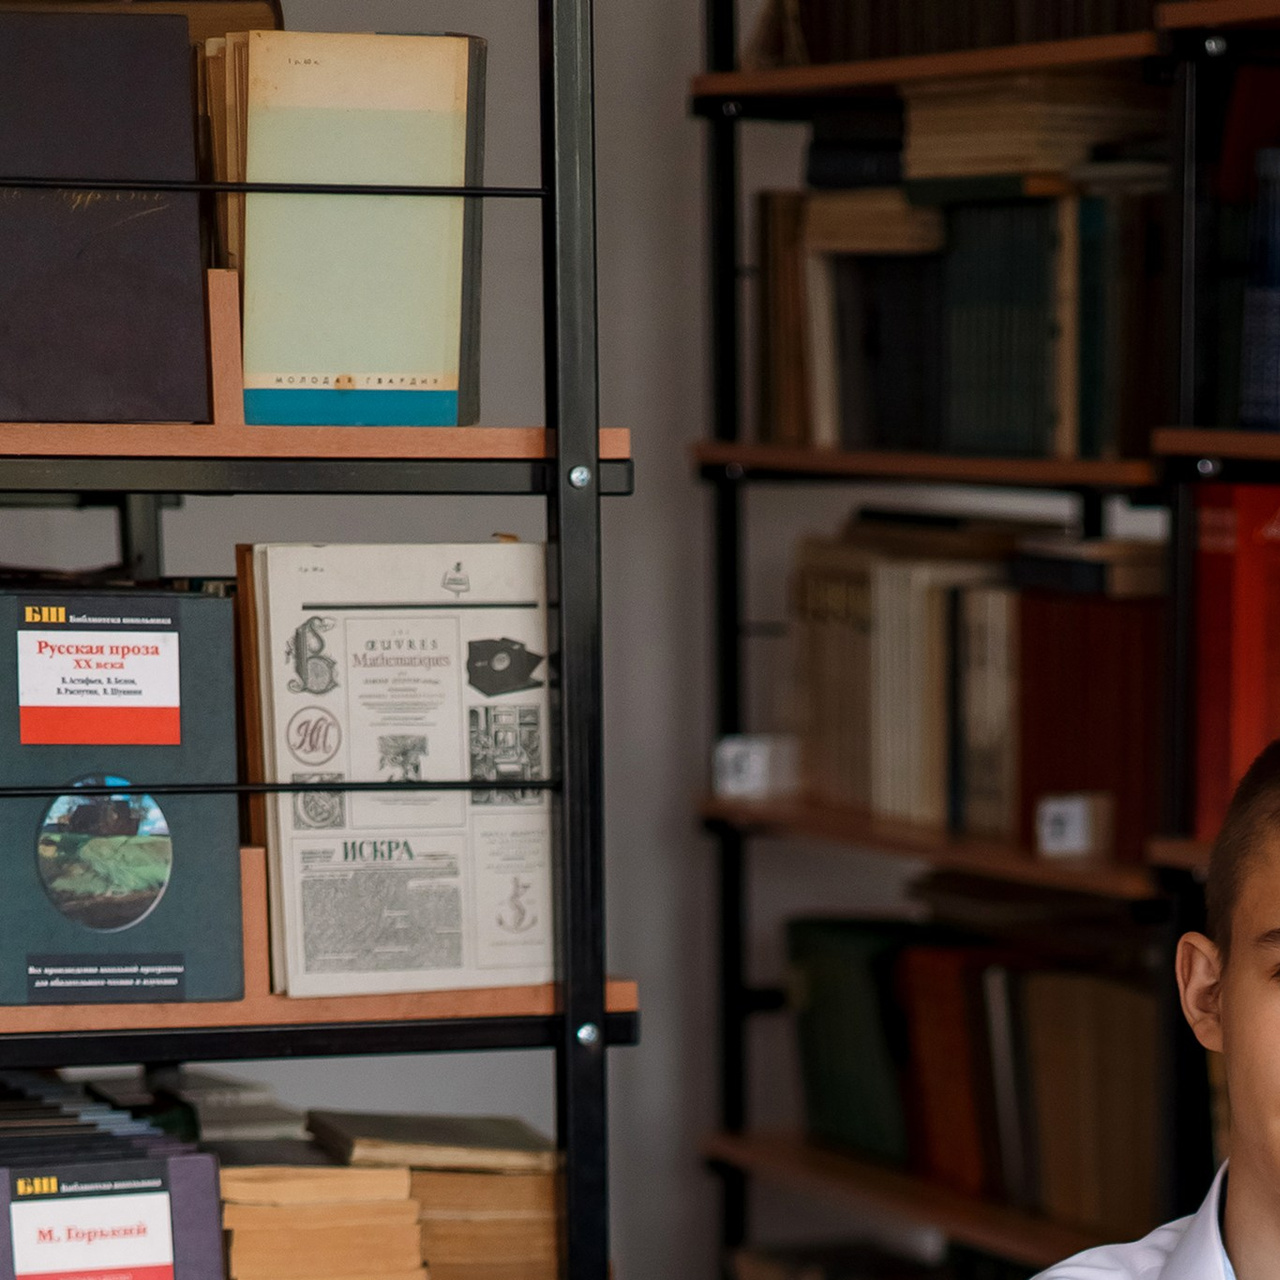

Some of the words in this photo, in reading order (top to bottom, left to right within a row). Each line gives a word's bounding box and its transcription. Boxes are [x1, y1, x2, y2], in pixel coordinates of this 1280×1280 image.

[275, 376, 353, 385] МОЛОДАЯ
[365, 377, 439, 385] ГВАРДИЯ
[24, 606, 66, 623] БШ
[36, 640, 104, 659] Русская
[109, 645, 160, 659] проза
[95, 660, 125, 670] века
[342, 840, 416, 862] ИСКРА
[16, 1175, 58, 1196] БШ
[37, 1228, 61, 1244] М.
[65, 1222, 148, 1245] Горький
